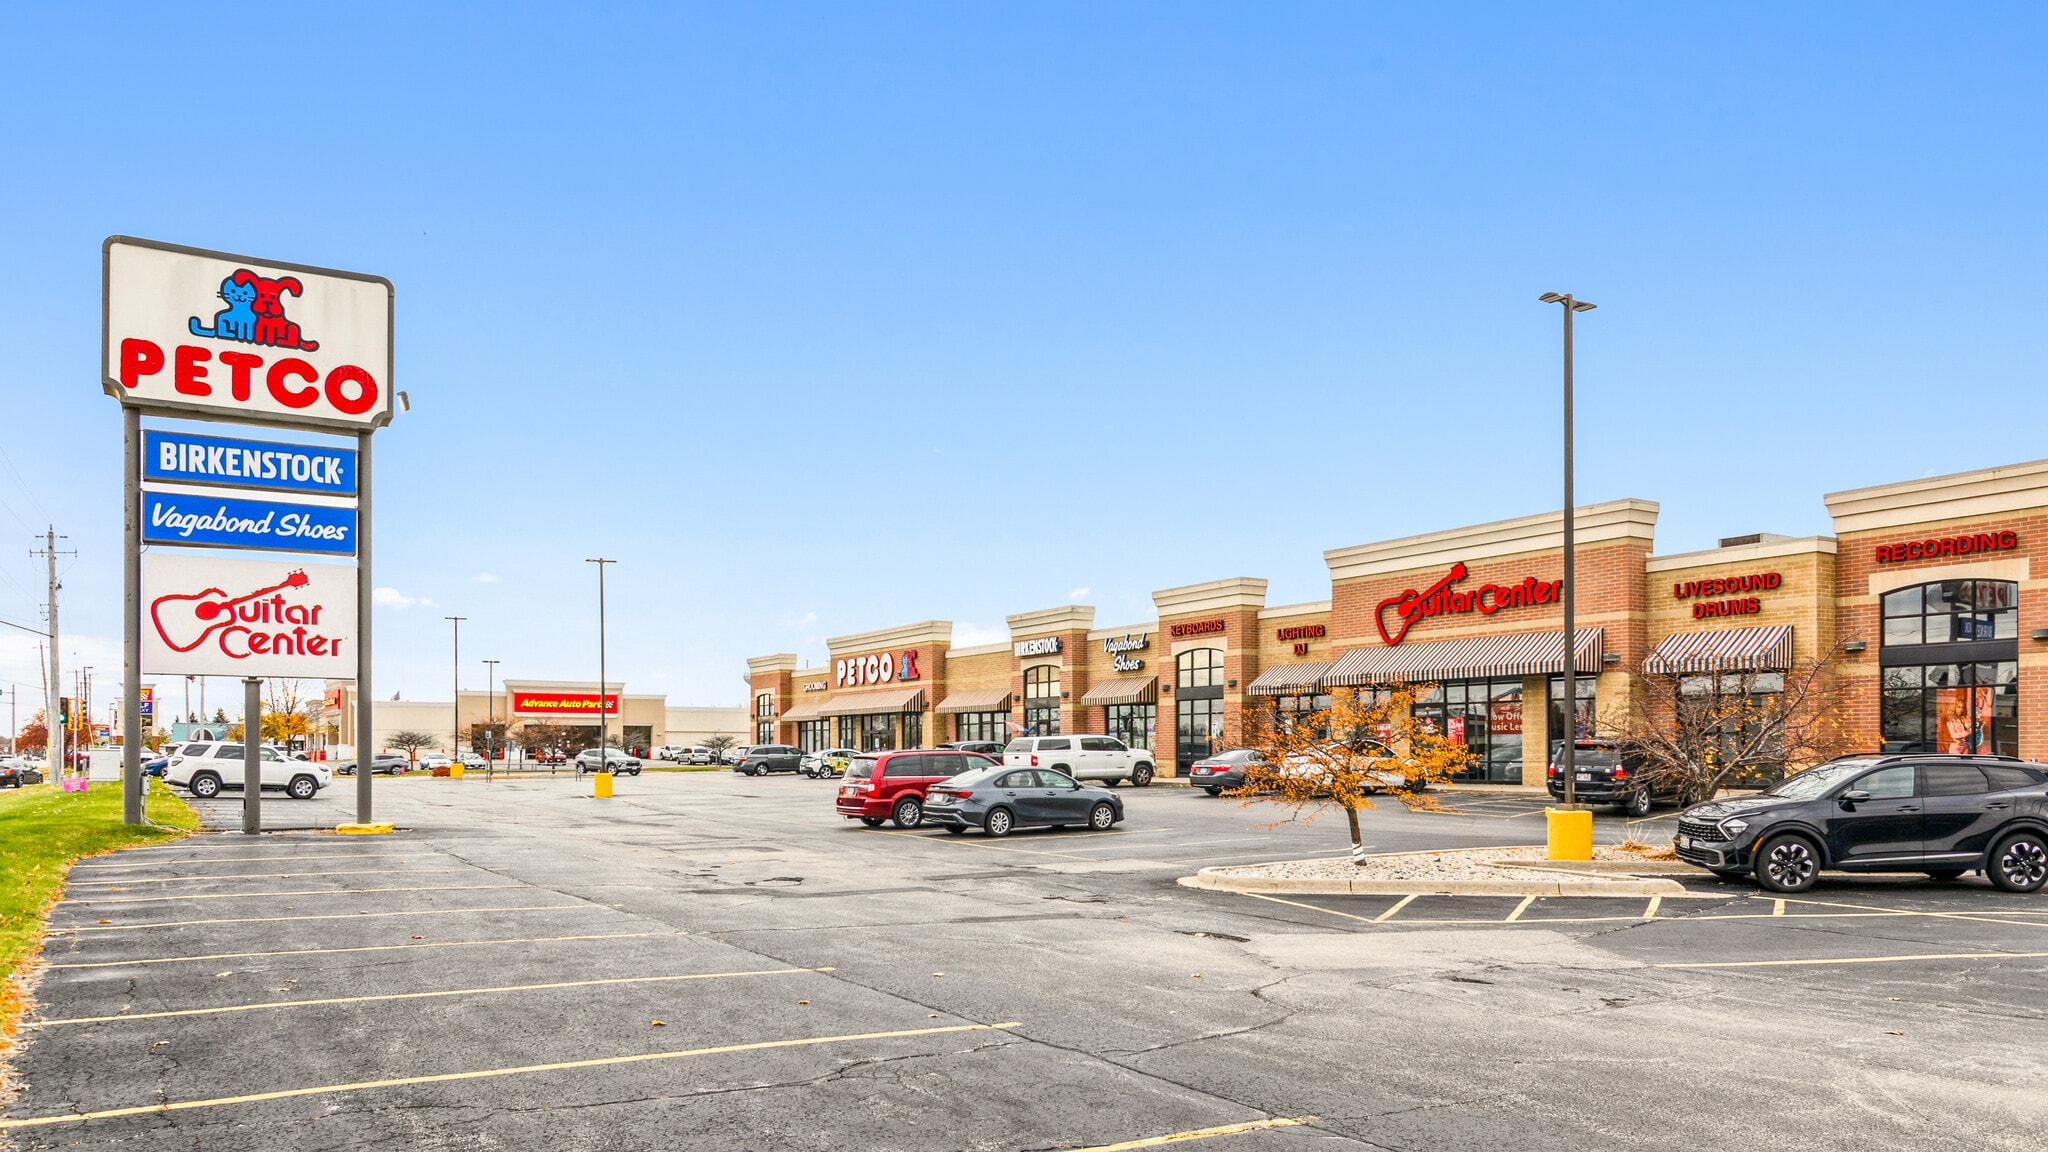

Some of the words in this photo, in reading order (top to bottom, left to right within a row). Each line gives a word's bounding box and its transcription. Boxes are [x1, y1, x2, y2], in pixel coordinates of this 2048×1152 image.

[120, 338, 378, 414] PETCO
[160, 442, 342, 484] BIRKENSTOCK
[152, 502, 275, 536] Vagabond
[275, 514, 348, 540] Shoes
[1876, 530, 2018, 563] RECORDING
[1476, 577, 1563, 614] Center
[1673, 572, 1781, 599] LIVESOUND
[1692, 597, 1760, 619] DRUMS
[1171, 620, 1224, 636] KEYBOARDS
[1277, 624, 1325, 640] LIGHTING
[219, 625, 342, 659] Center
[1014, 637, 1059, 657] BIRKENSTOCK
[1104, 633, 1146, 656] Vagabond
[1293, 643, 1308, 655] DJ
[837, 652, 893, 686] PETCO
[1113, 654, 1141, 671] Shoes
[803, 681, 828, 691] GROOMING
[521, 699, 558, 708] Advance
[559, 699, 581, 708] Auto
